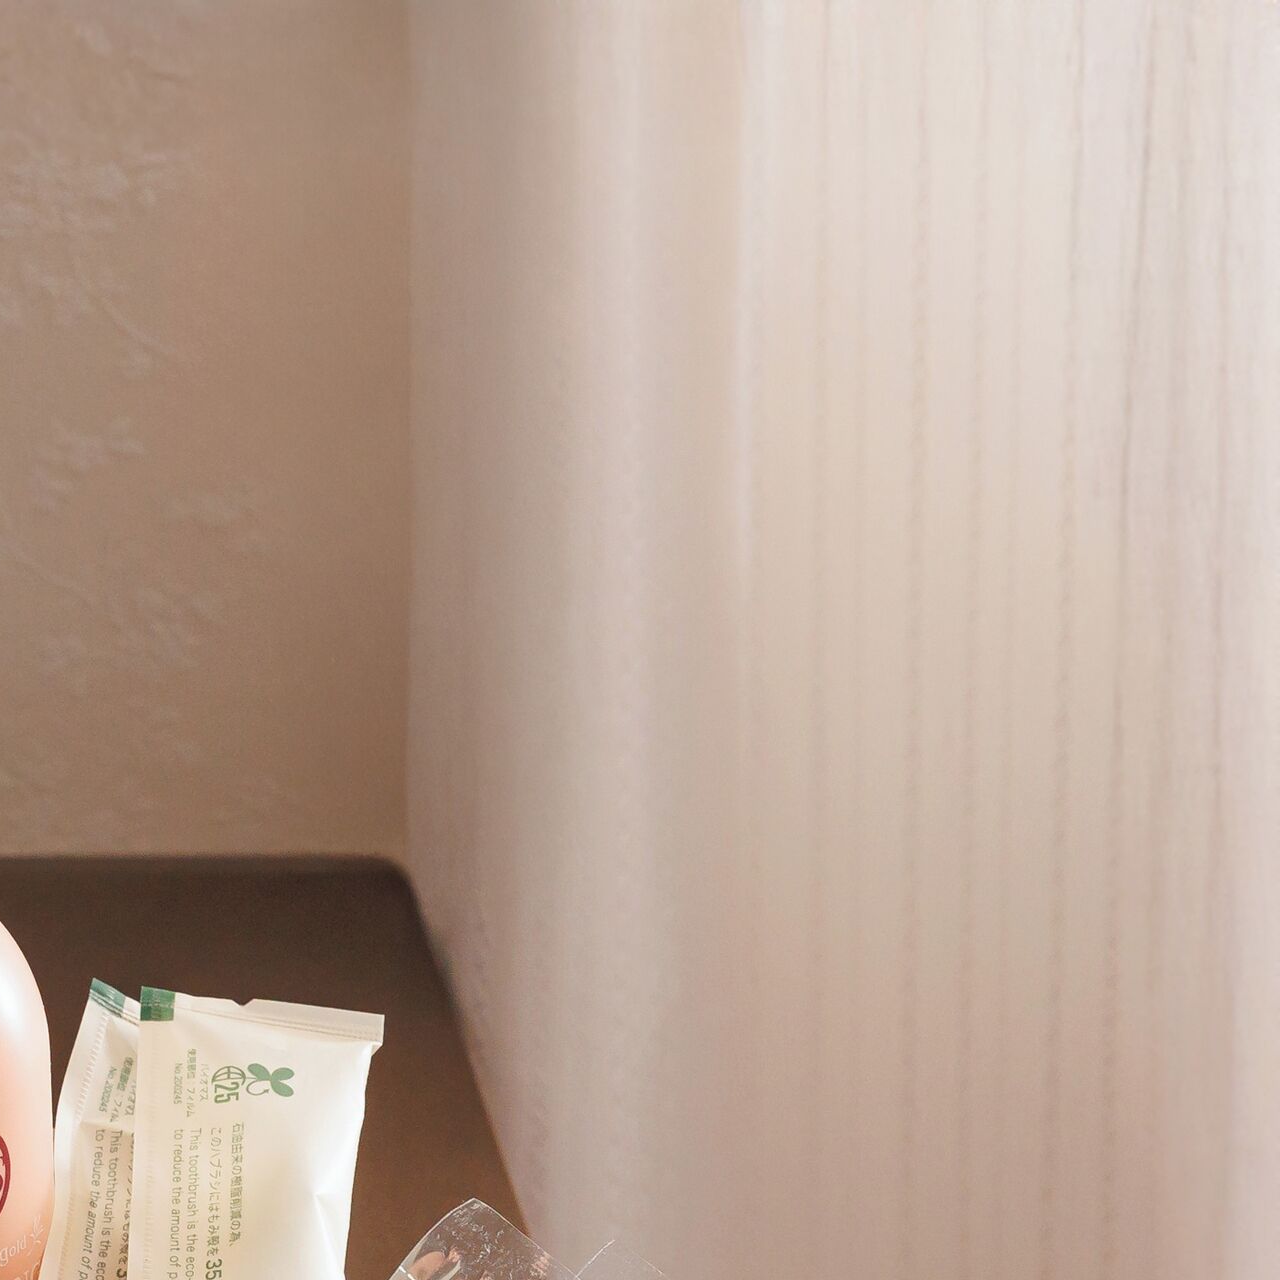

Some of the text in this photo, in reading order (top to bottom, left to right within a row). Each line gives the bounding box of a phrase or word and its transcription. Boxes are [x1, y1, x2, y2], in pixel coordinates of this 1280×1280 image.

[214, 1081, 239, 1104] 25
[95, 1129, 105, 1142] to
[110, 1129, 123, 1153] This
[173, 1128, 184, 1141] to
[189, 1127, 202, 1151] This
[91, 1146, 104, 1187] reduce
[172, 1144, 184, 1183] reduce
[103, 1157, 119, 1224] toothbrush
[171, 1186, 182, 1205] the
[187, 1154, 200, 1217] toothbrush
[89, 1191, 101, 1209] the
[82, 1210, 97, 1253] amount
[101, 1227, 114, 1236] is
[170, 1208, 180, 1252] amount
[187, 1220, 199, 1230] is
[0, 1234, 27, 1267] gold
[98, 1240, 112, 1258] the
[186, 1233, 199, 1253] the
[81, 1256, 93, 1270] of
[169, 1255, 181, 1268] of
